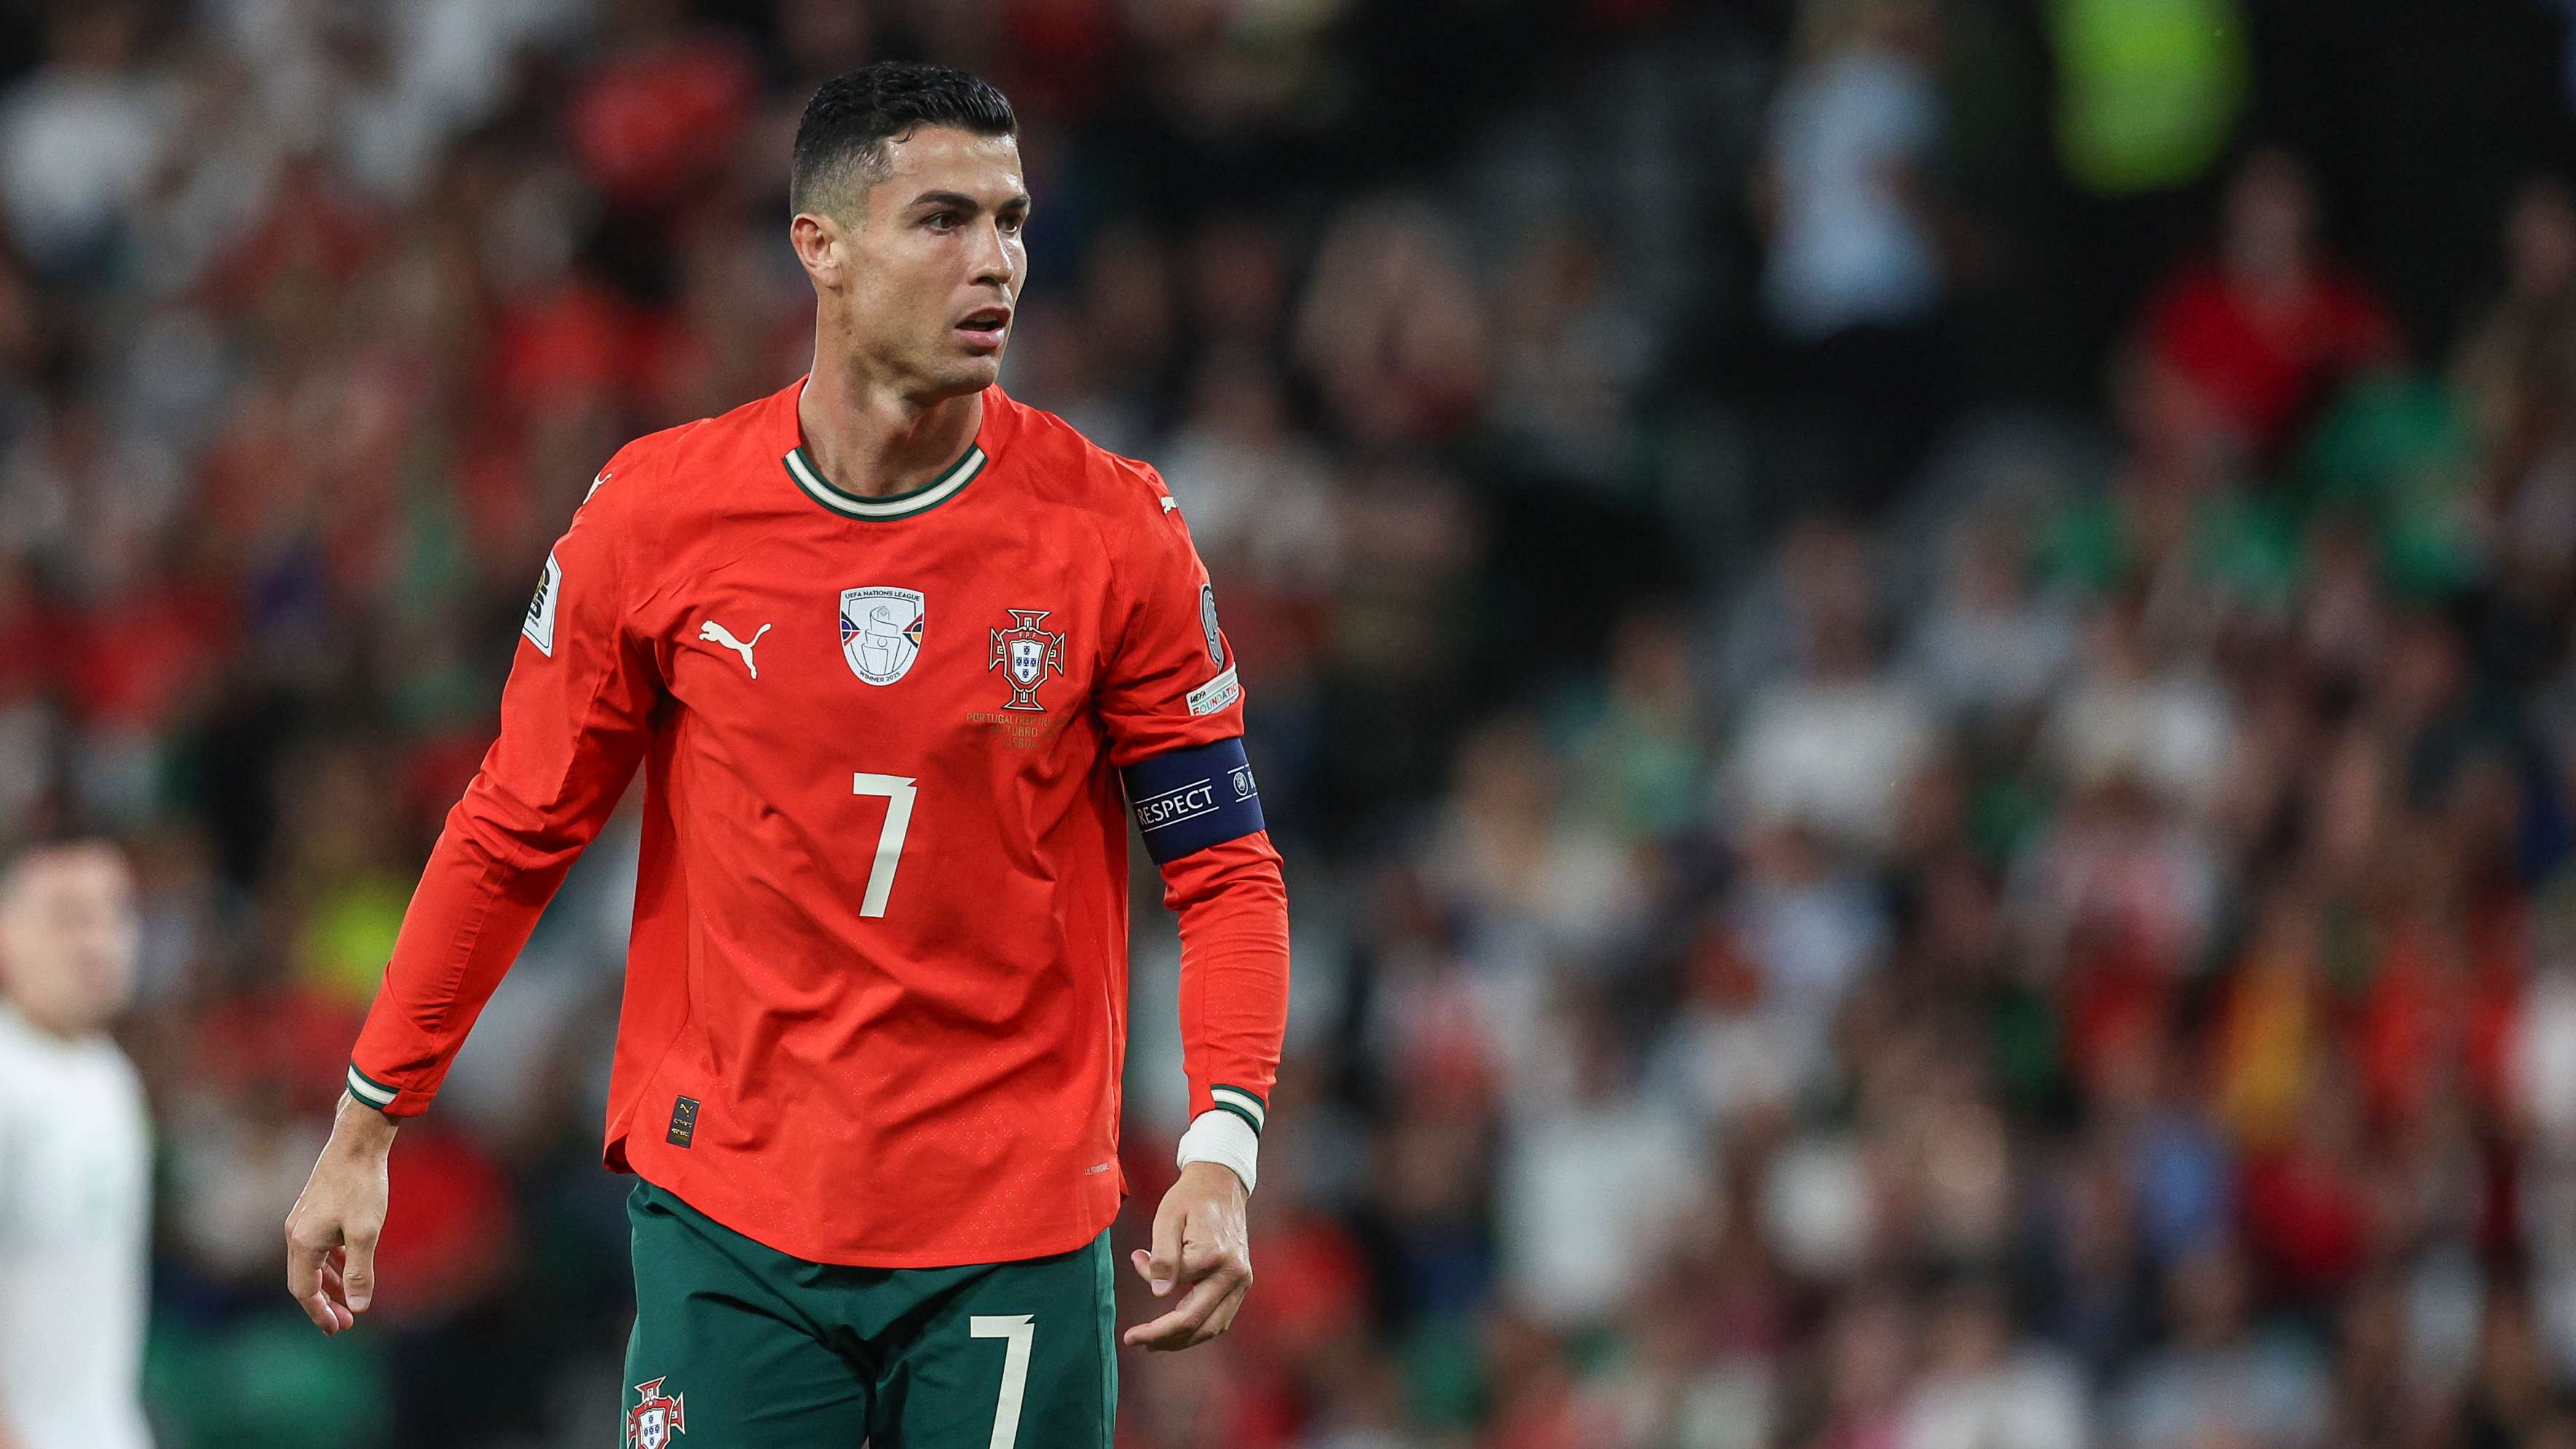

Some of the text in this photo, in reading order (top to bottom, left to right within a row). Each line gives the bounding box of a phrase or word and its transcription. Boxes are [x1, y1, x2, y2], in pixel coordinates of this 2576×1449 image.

[895, 592, 921, 601] LEAGUE
[860, 670, 884, 683] WINNER
[1190, 691, 1206, 704] UEFA
[1137, 785, 1212, 825] RESPECT
[853, 772, 917, 918] 7
[970, 1314, 1035, 1449] 7
